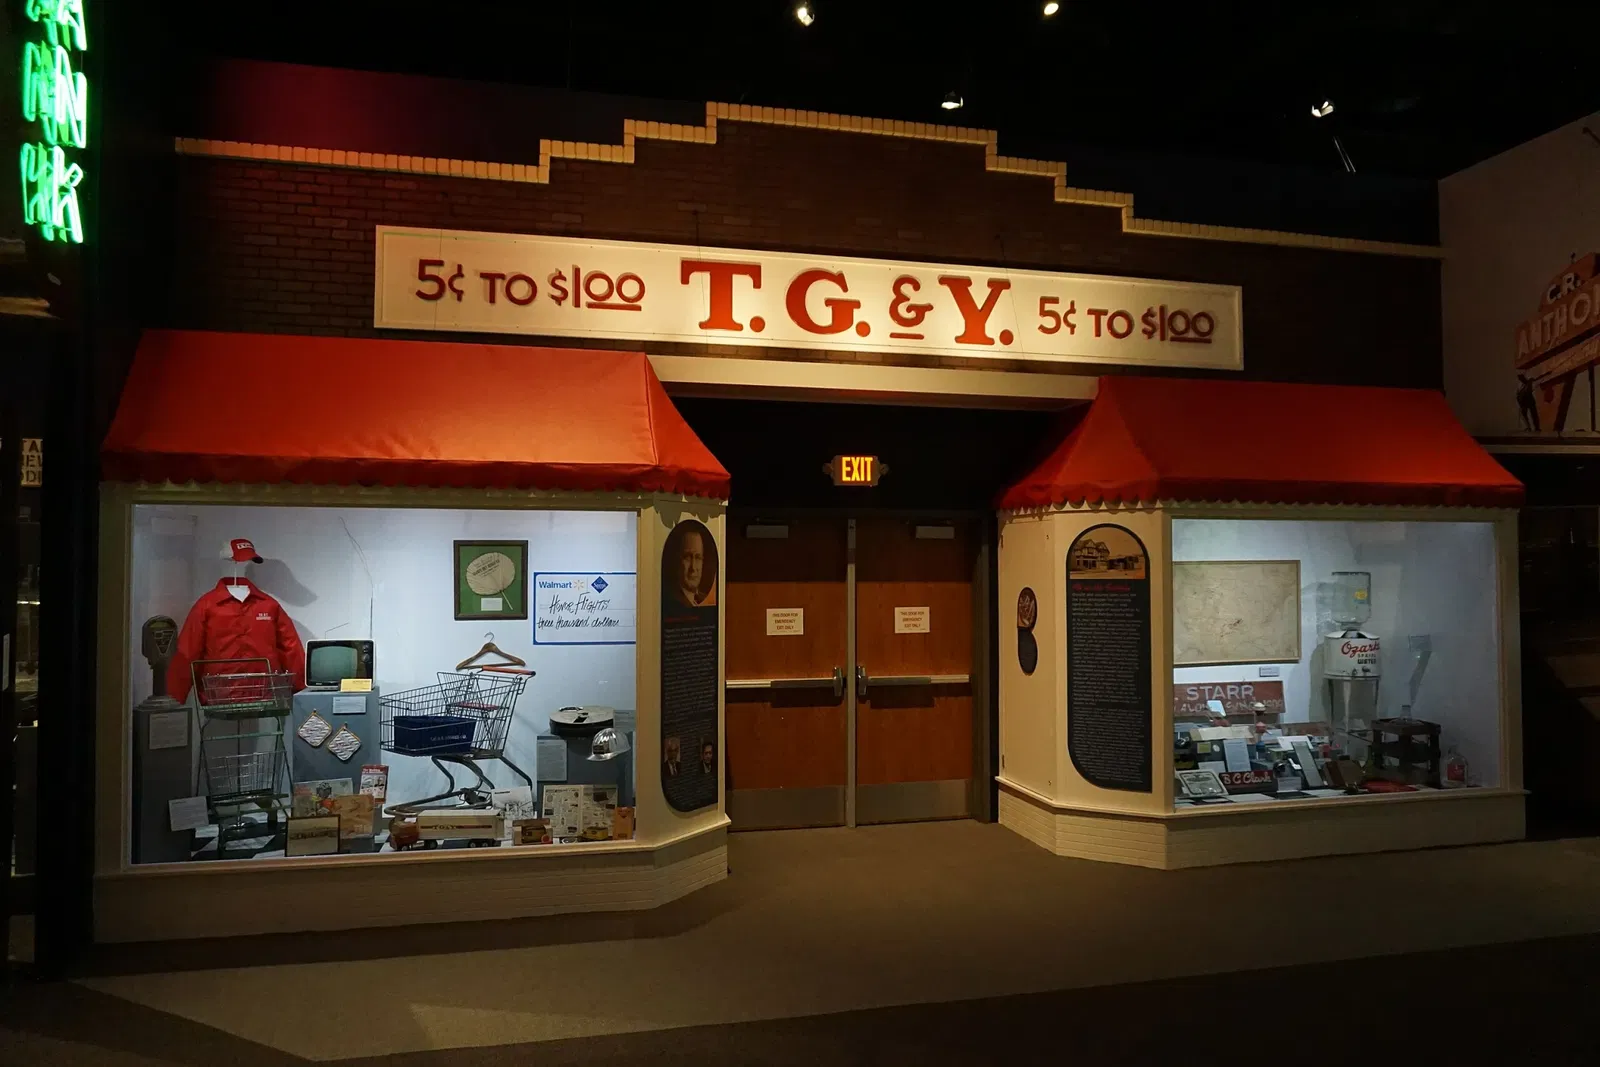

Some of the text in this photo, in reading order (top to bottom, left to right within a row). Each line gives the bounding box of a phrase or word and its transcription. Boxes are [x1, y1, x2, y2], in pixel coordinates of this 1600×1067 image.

[479, 271, 538, 306] TO
[1086, 308, 1135, 340] TO
[1517, 284, 1600, 360] ANTHO
[841, 456, 873, 482] EXIT
[539, 581, 573, 589] Walmart
